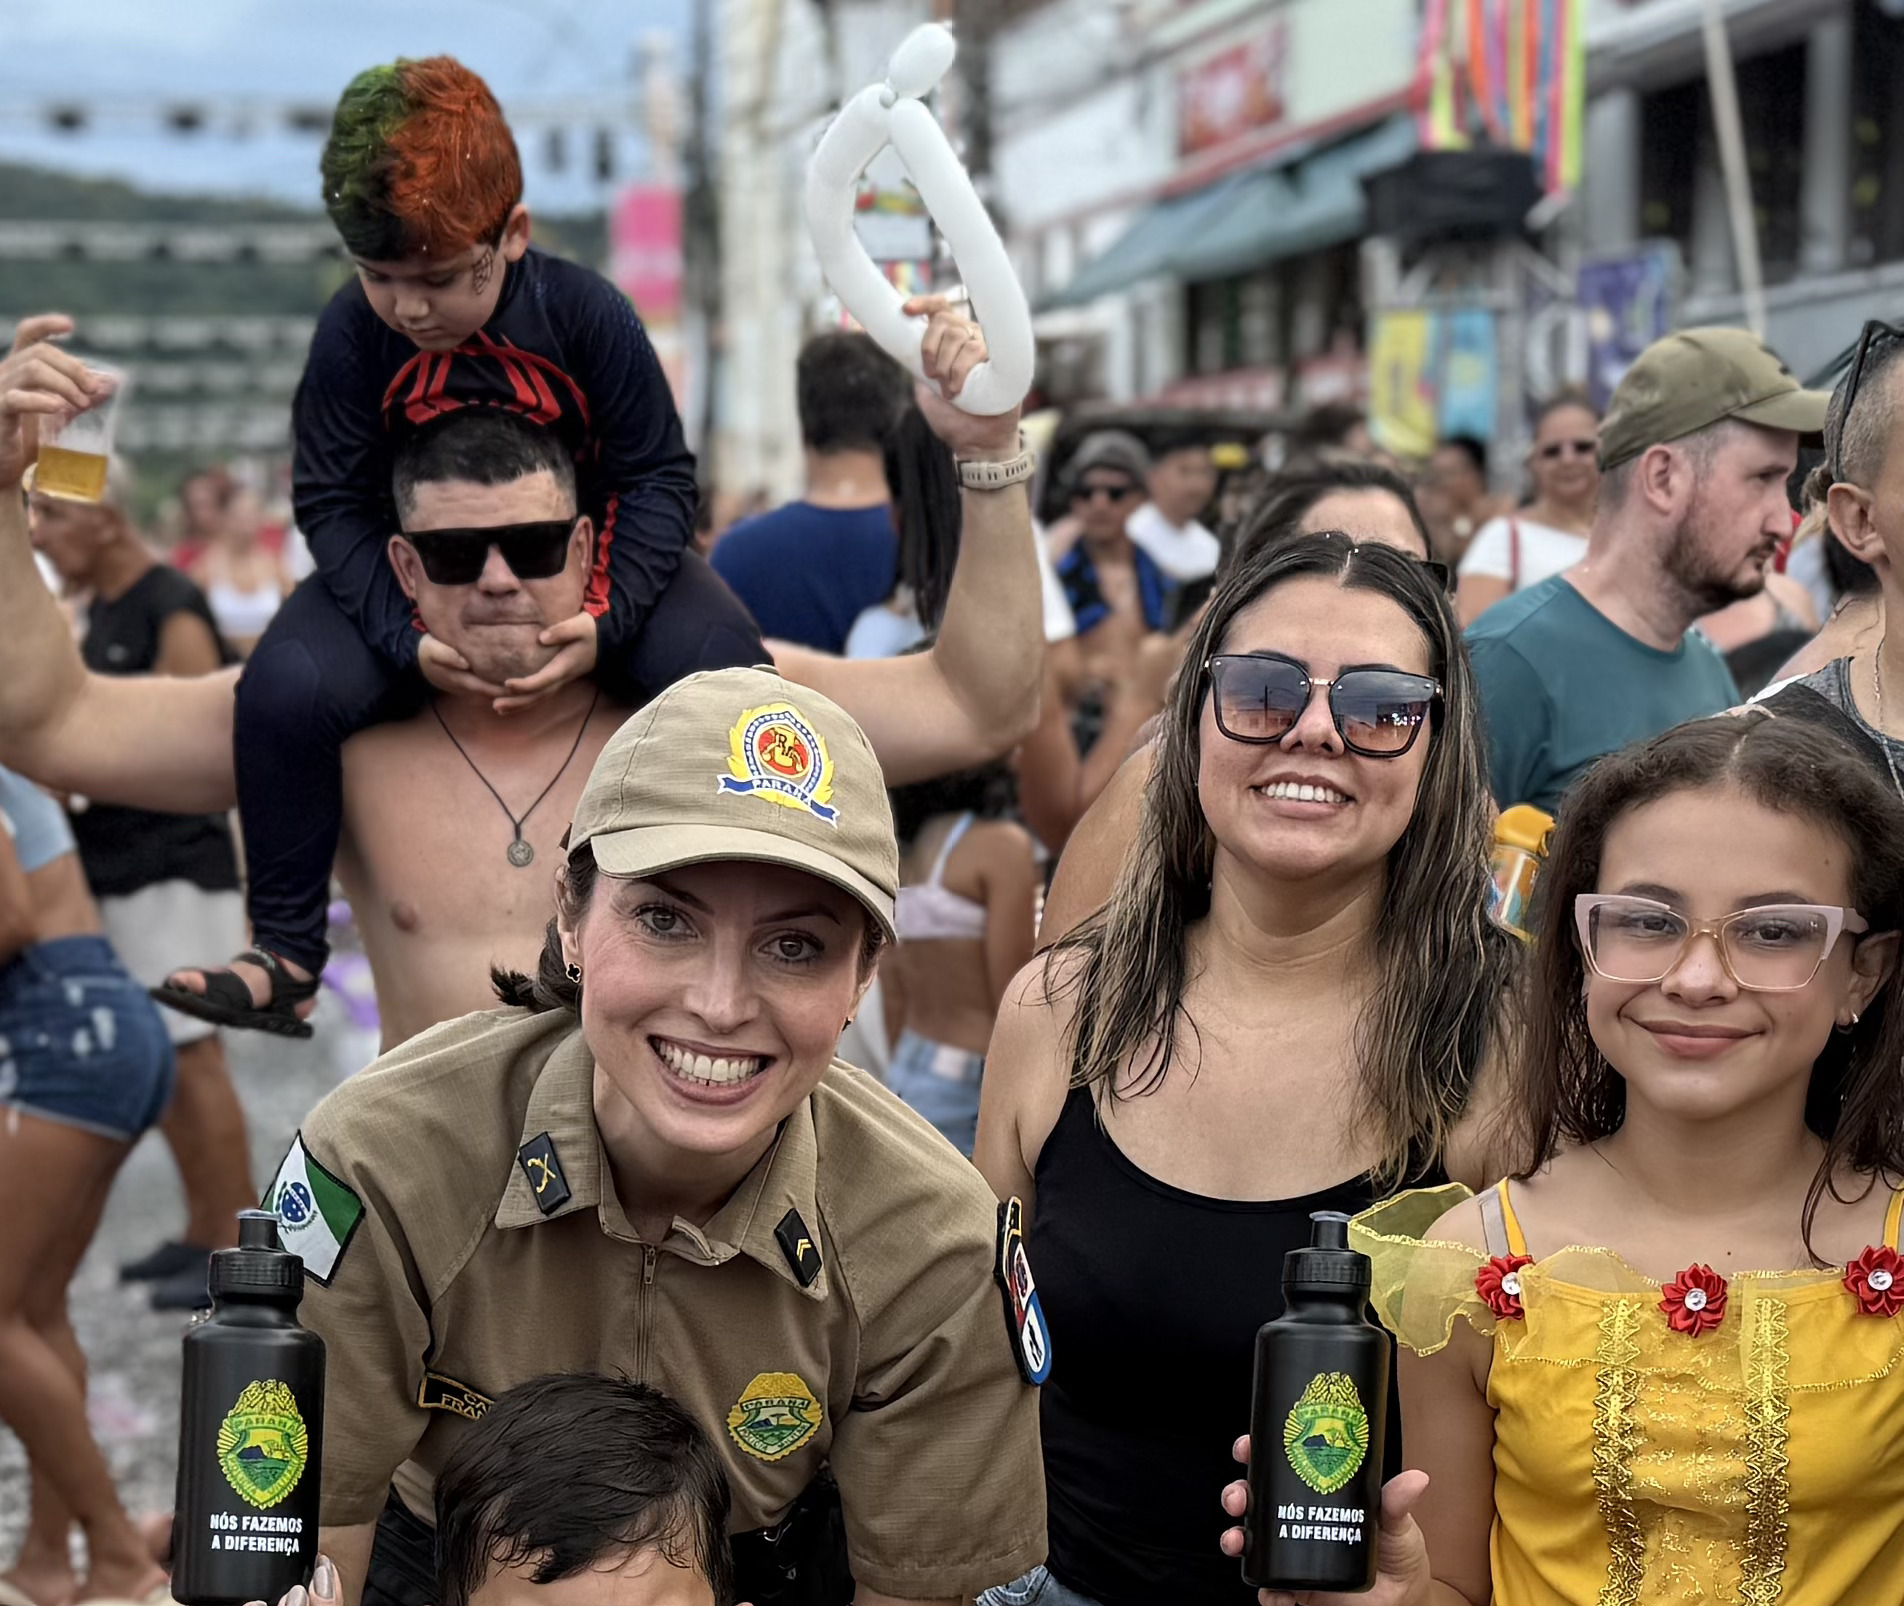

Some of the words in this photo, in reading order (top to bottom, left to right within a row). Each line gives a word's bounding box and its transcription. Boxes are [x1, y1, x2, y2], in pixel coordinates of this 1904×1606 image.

[210, 1512, 239, 1531] NÓS
[242, 1516, 303, 1534] FAZEMOS
[1277, 1503, 1305, 1520] NÓS
[1308, 1506, 1365, 1523] FAZEMOS
[1279, 1524, 1288, 1539] A
[1291, 1525, 1362, 1545] DIFERENÇA
[211, 1535, 221, 1550] A
[224, 1535, 300, 1556] DIFERENÇA
